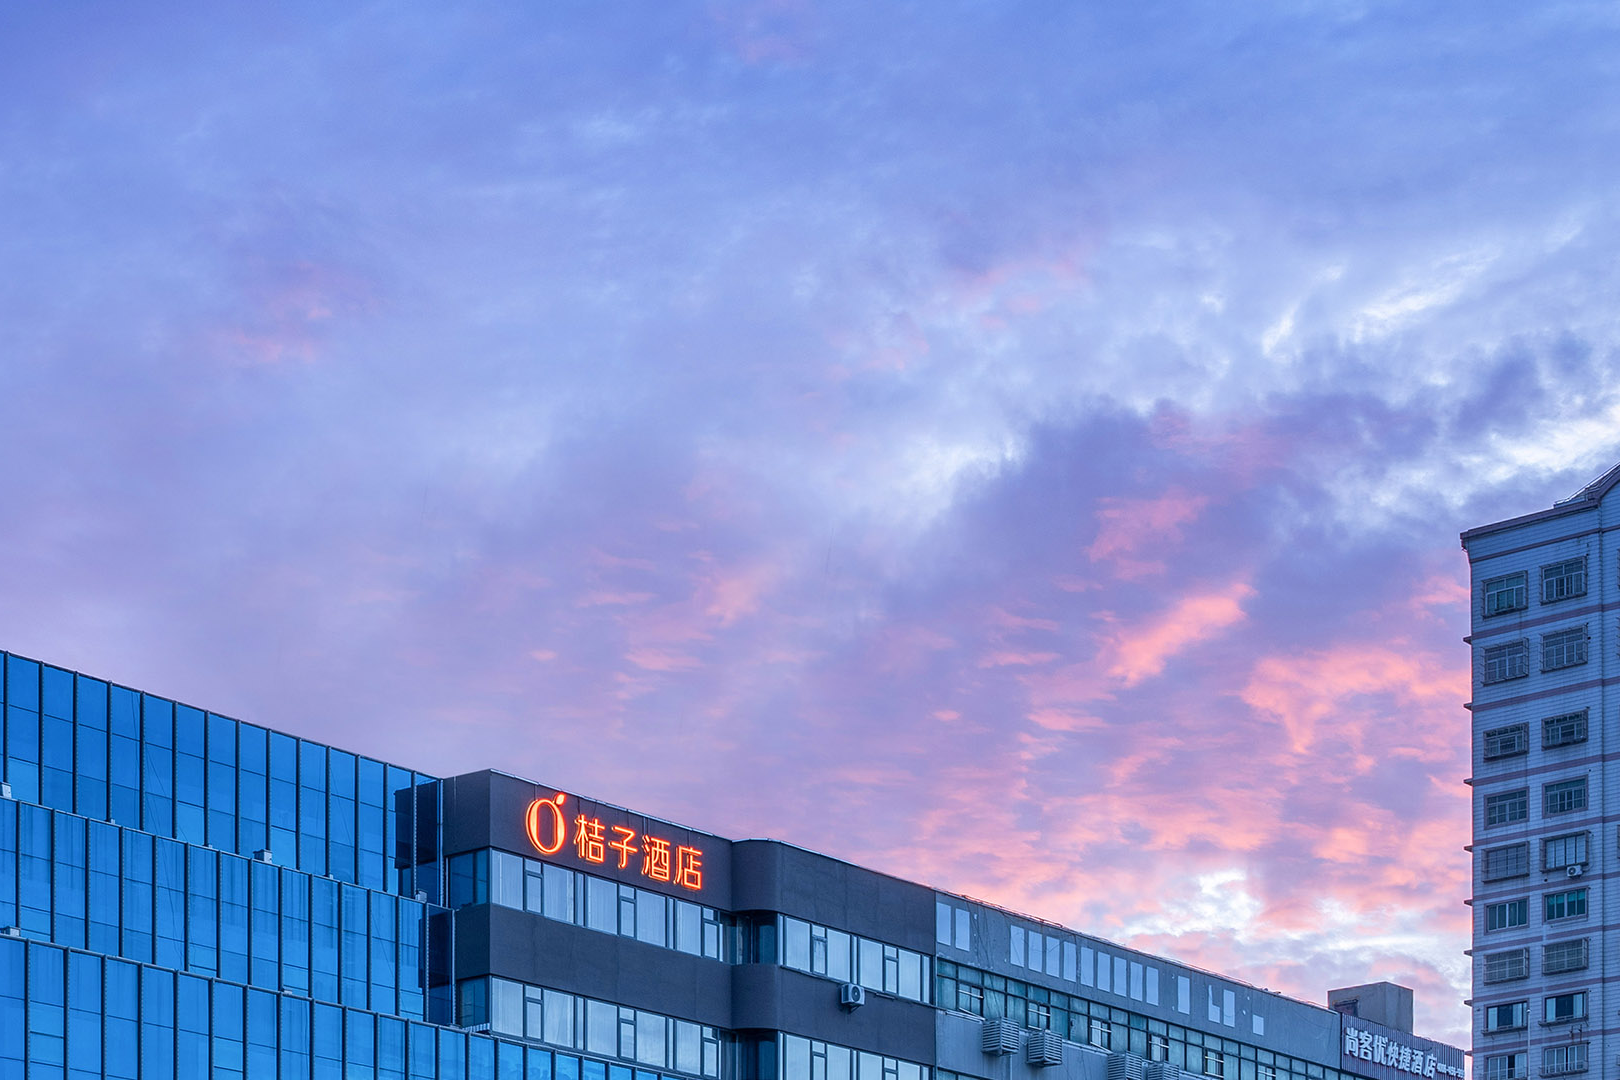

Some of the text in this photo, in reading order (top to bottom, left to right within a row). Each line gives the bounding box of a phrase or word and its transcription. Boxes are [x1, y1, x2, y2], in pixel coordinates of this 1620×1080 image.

[574, 814, 703, 890] 桔子酒店
[1344, 1026, 1437, 1078] 尚客优快捷酒店
